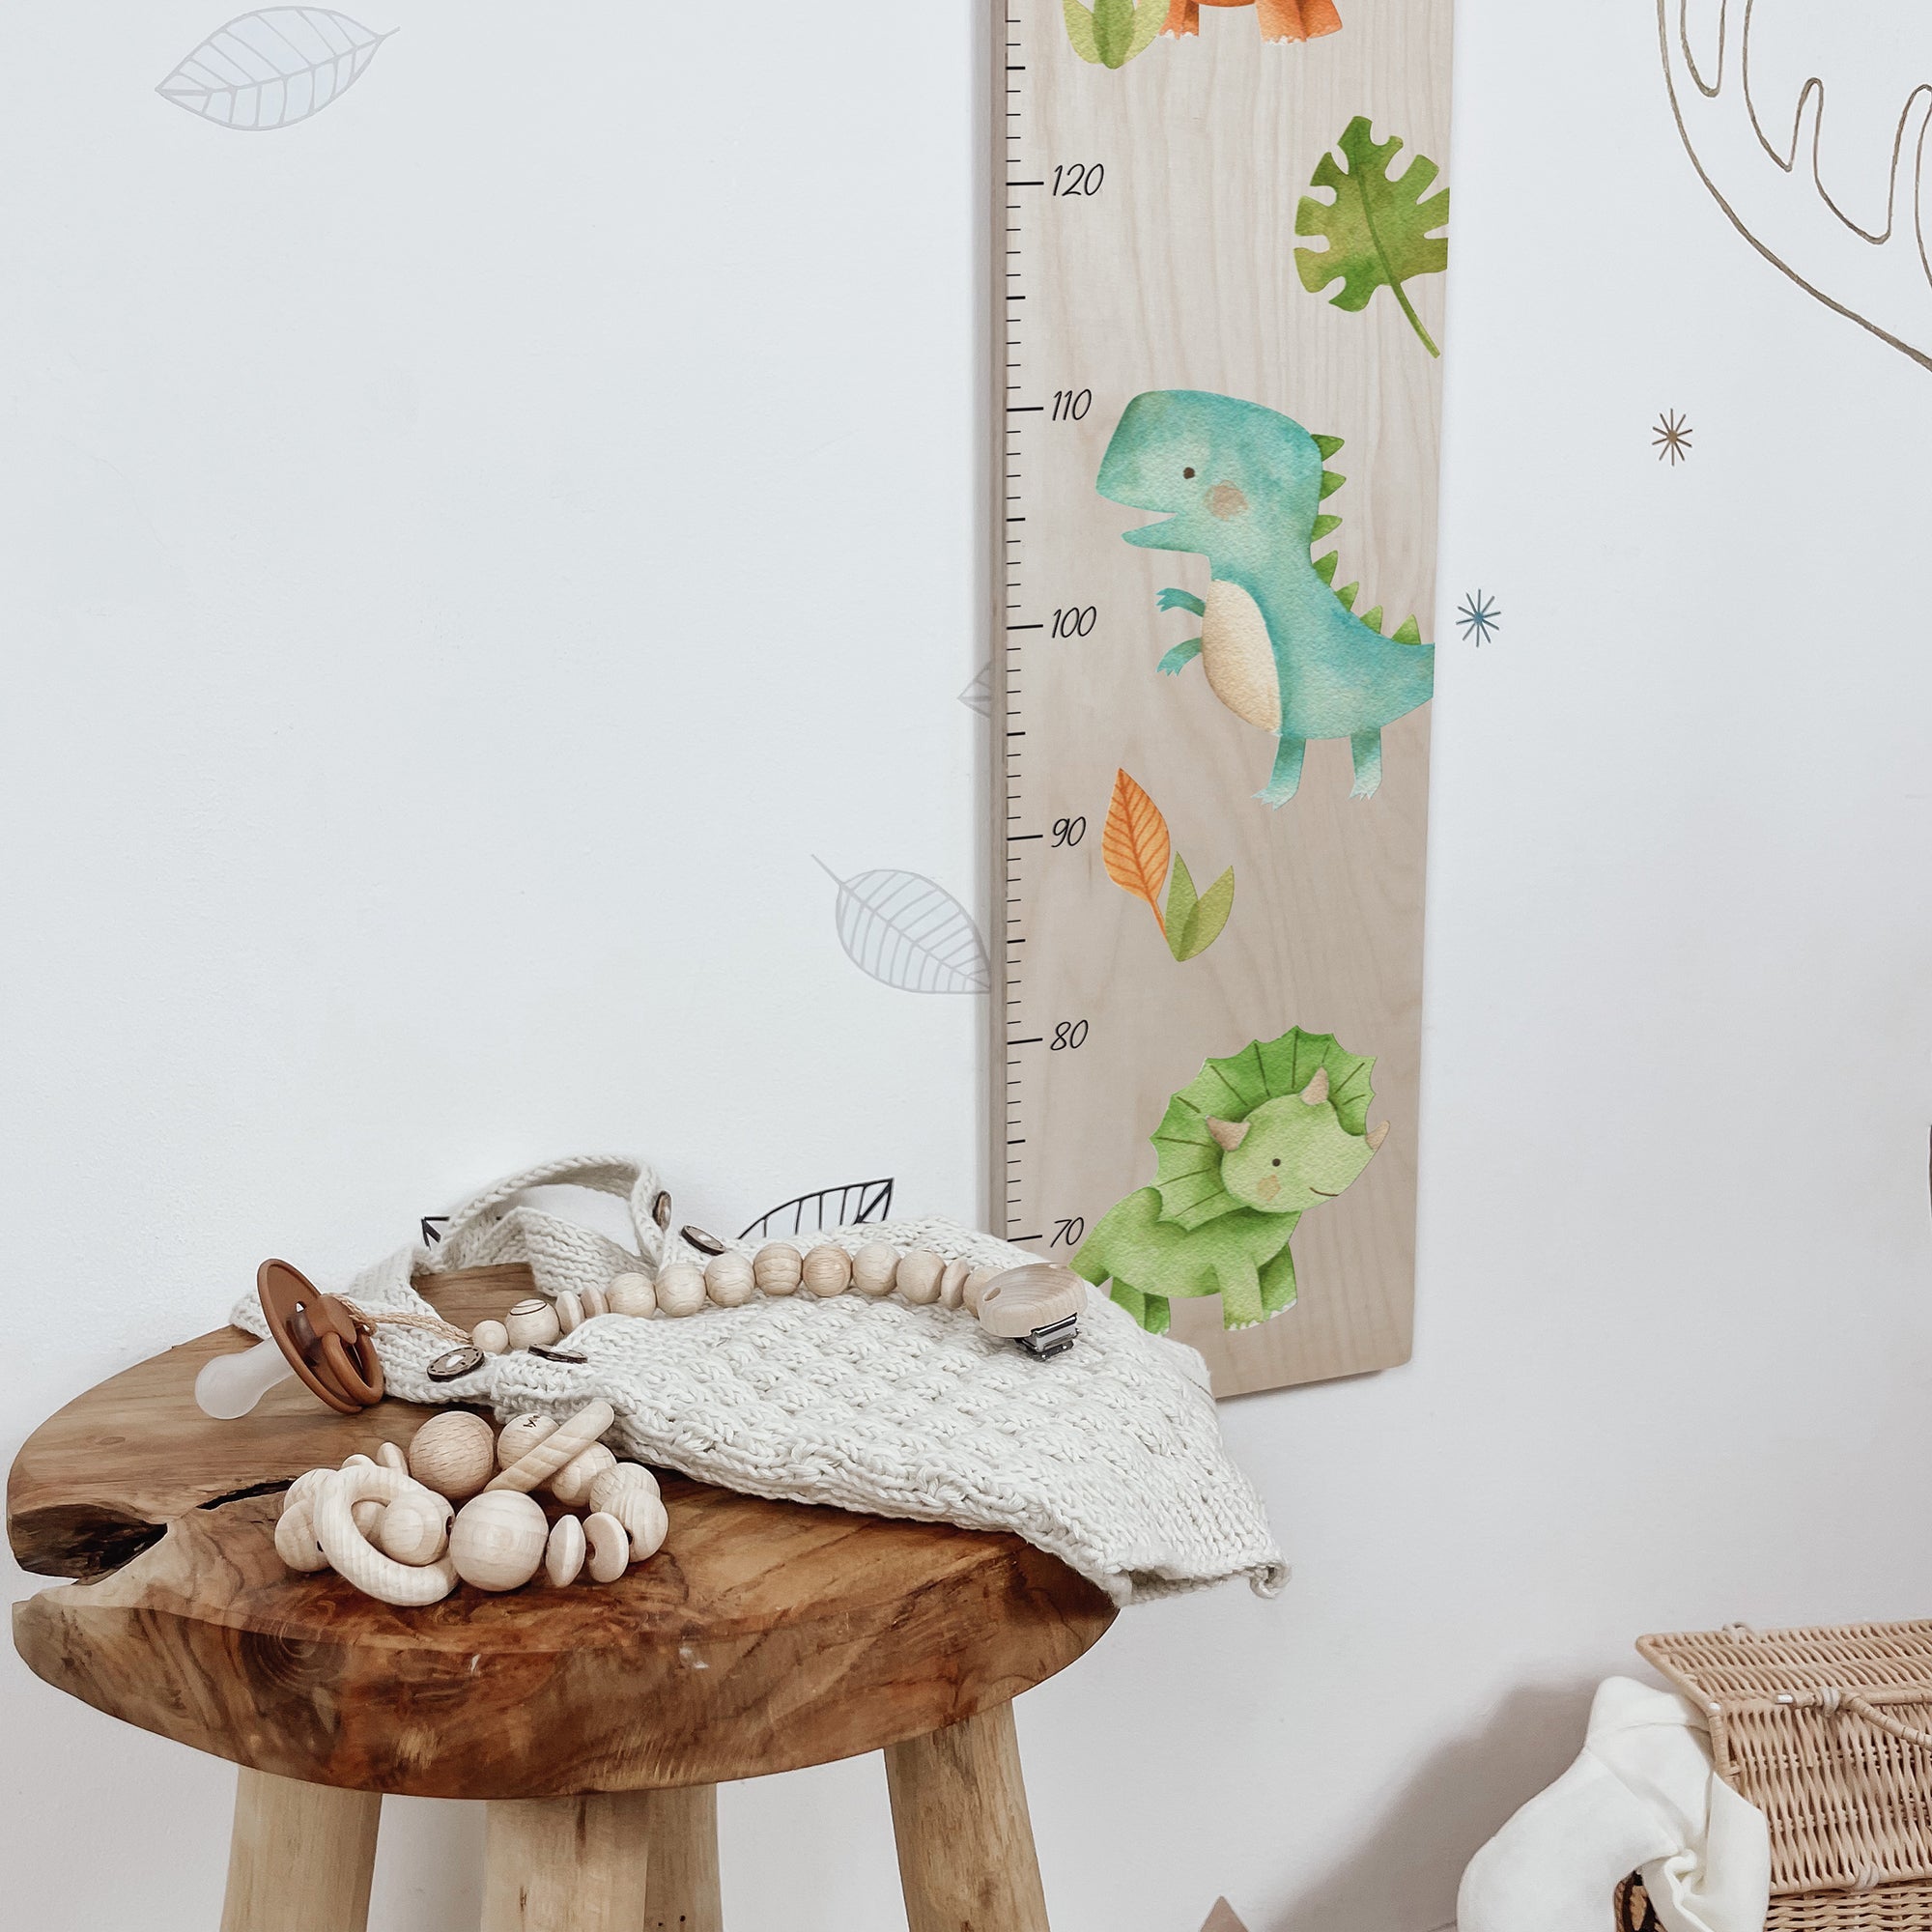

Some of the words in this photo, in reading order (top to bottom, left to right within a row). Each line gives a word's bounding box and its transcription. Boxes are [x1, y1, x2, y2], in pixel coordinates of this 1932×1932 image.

[1052, 163, 1105, 197] 120
[1052, 388, 1093, 421] 110
[1051, 606, 1097, 639] 100
[1050, 815, 1087, 848] 90
[1049, 1019, 1089, 1051] 80
[1049, 1216, 1085, 1248] 70
